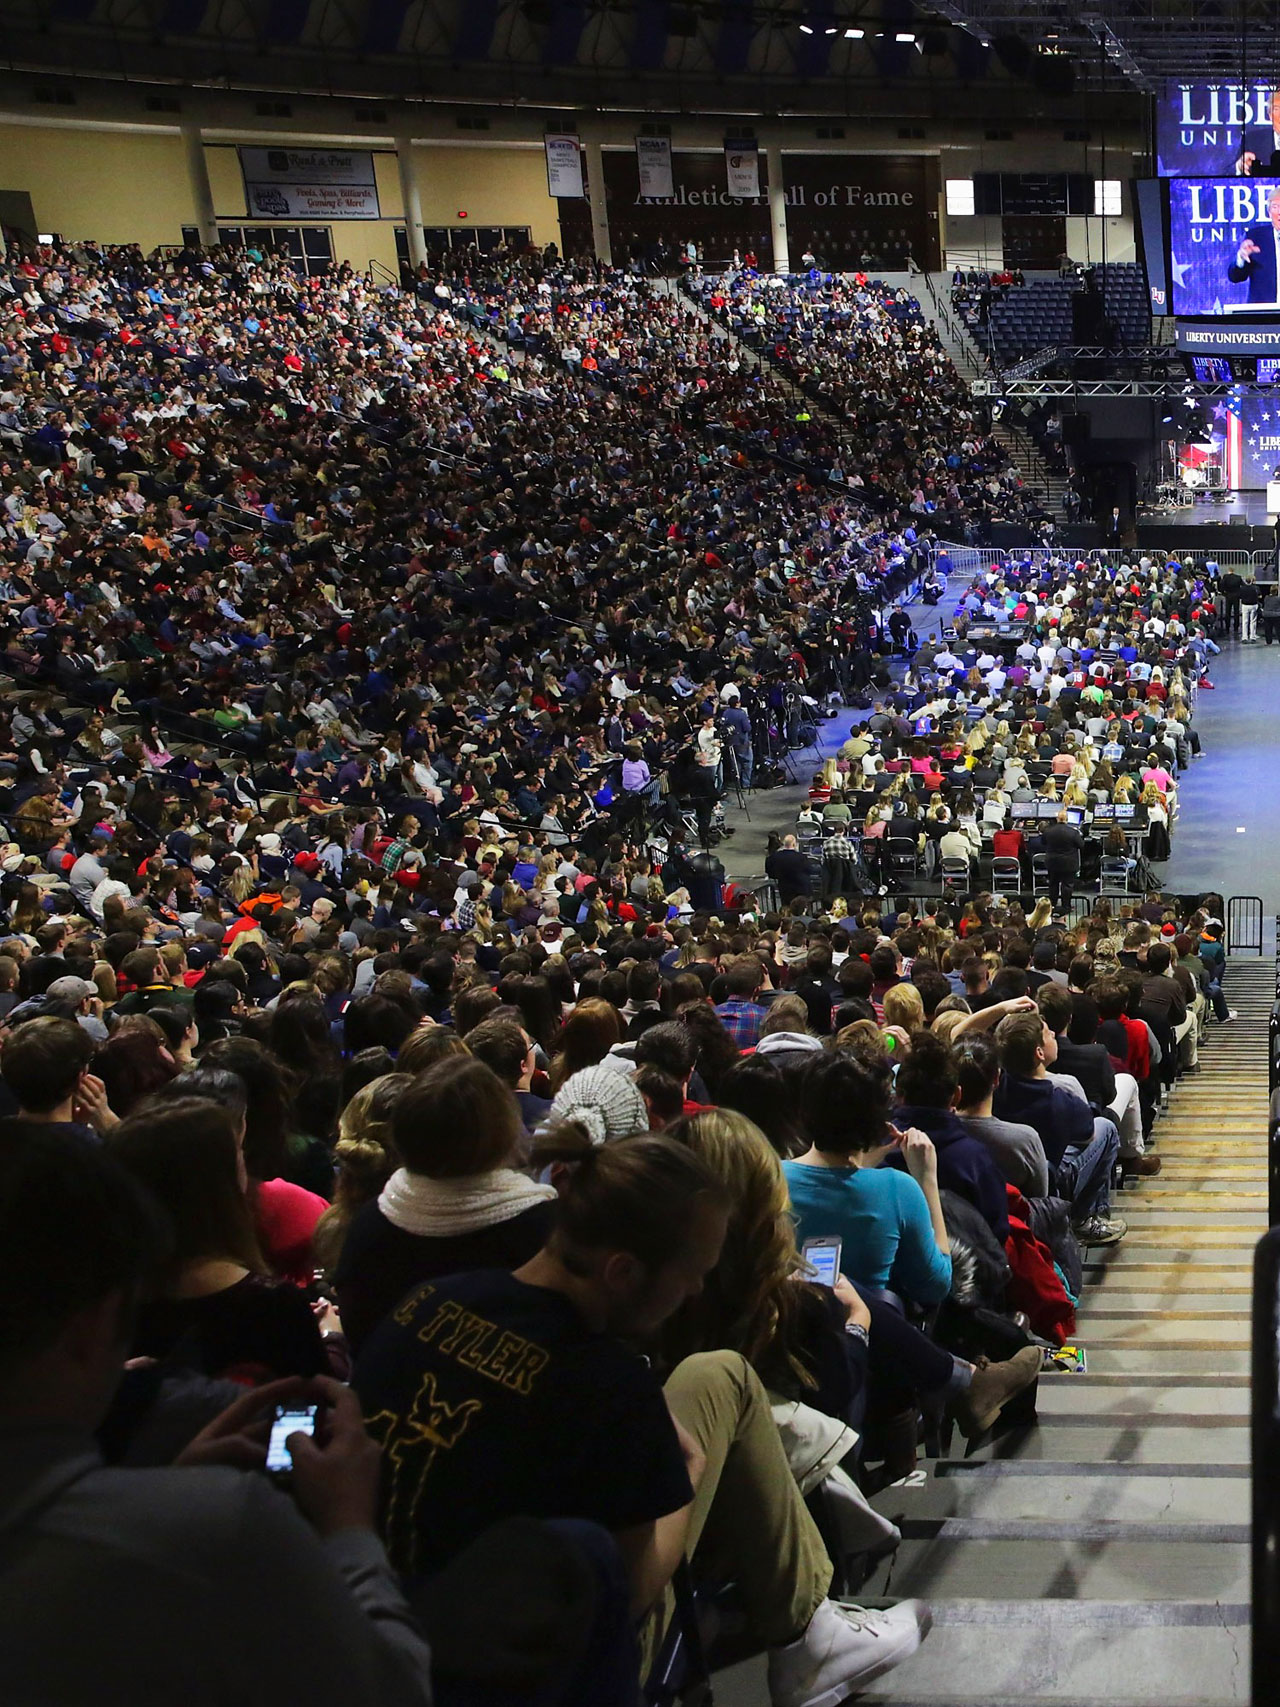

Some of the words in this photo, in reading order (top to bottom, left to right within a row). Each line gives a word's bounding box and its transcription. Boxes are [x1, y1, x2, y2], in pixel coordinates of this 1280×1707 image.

[814, 185, 836, 206] of
[845, 186, 914, 206] Fame
[307, 198, 335, 209] Gaming
[346, 198, 365, 207] More!
[1186, 331, 1215, 342] LIBERTY
[1216, 333, 1280, 344] UNIVERSITY
[1193, 357, 1223, 368] LIBETY
[418, 1299, 550, 1395] TYLER
